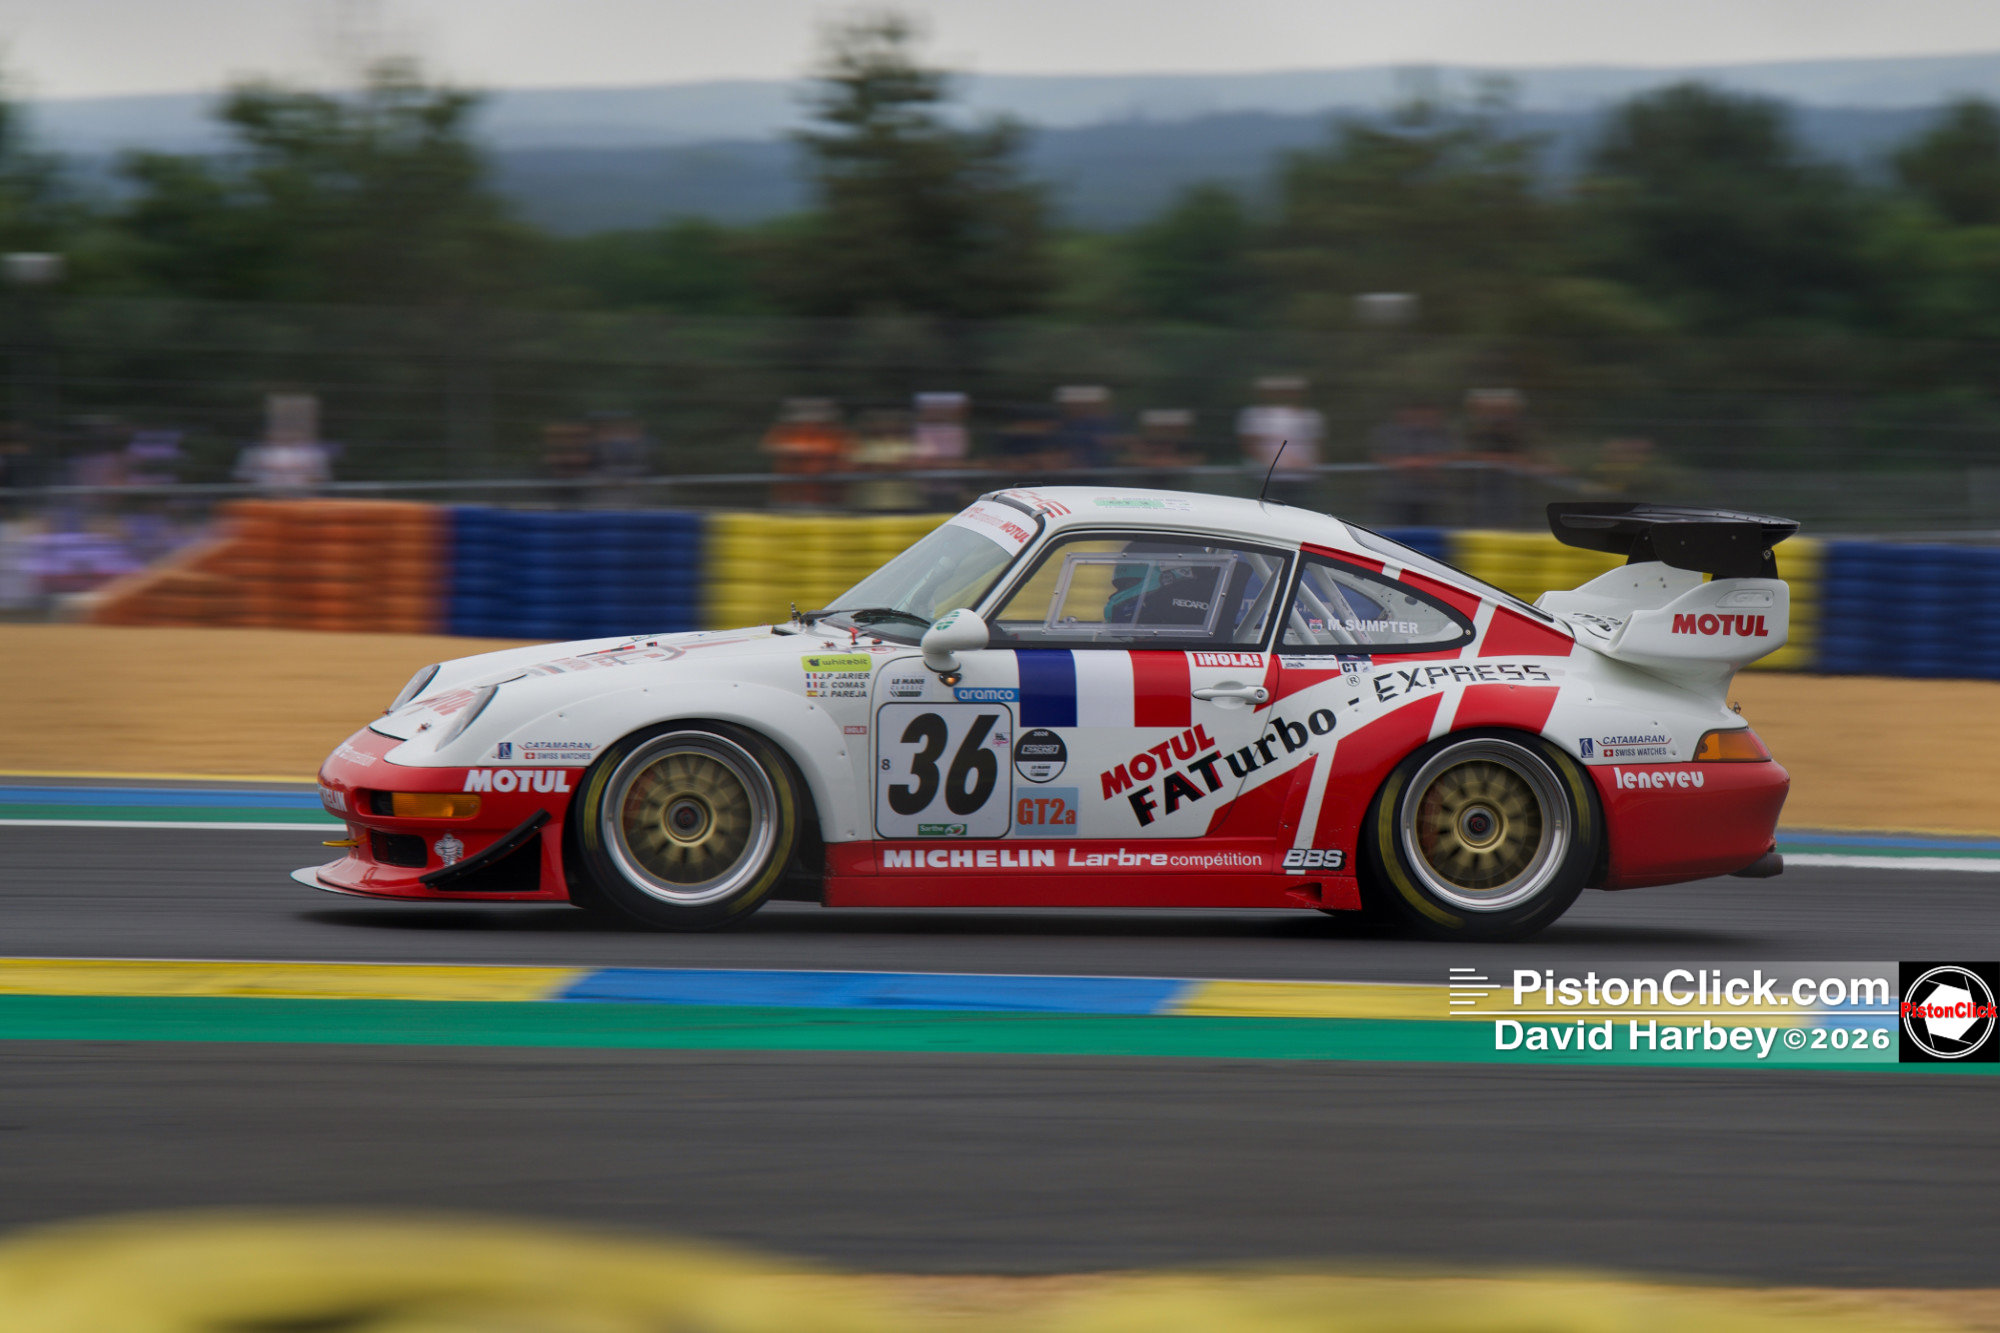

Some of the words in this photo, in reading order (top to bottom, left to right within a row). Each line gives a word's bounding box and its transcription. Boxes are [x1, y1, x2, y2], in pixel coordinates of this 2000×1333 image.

[999, 521, 1031, 544] MOTUL
[1672, 613, 1769, 636] MOTUL
[835, 672, 871, 680] JARIER
[1341, 662, 1358, 673] CT
[831, 681, 866, 689] COMAS
[1373, 664, 1551, 703] EXPRESS
[830, 690, 868, 698] PAREJA
[959, 689, 1015, 700] aramco
[525, 741, 592, 749] CATAMARAN
[1603, 735, 1665, 745] CATAMARAN
[537, 752, 559, 760] SWISS
[560, 752, 592, 760] WATCHES
[1615, 748, 1635, 757] SWISS
[1637, 747, 1667, 757] WATCHES
[881, 758, 891, 771] 8
[888, 712, 1000, 816] 36
[1100, 723, 1215, 801] MOTUL
[463, 768, 571, 794] MOTUL
[1613, 766, 1704, 789] leneveu
[1017, 798, 1077, 825] GT2a
[884, 849, 1055, 869] MICHELIN
[1068, 848, 1168, 868] Larbre
[1169, 850, 1263, 870] compétition
[1282, 849, 1347, 870] BBS
